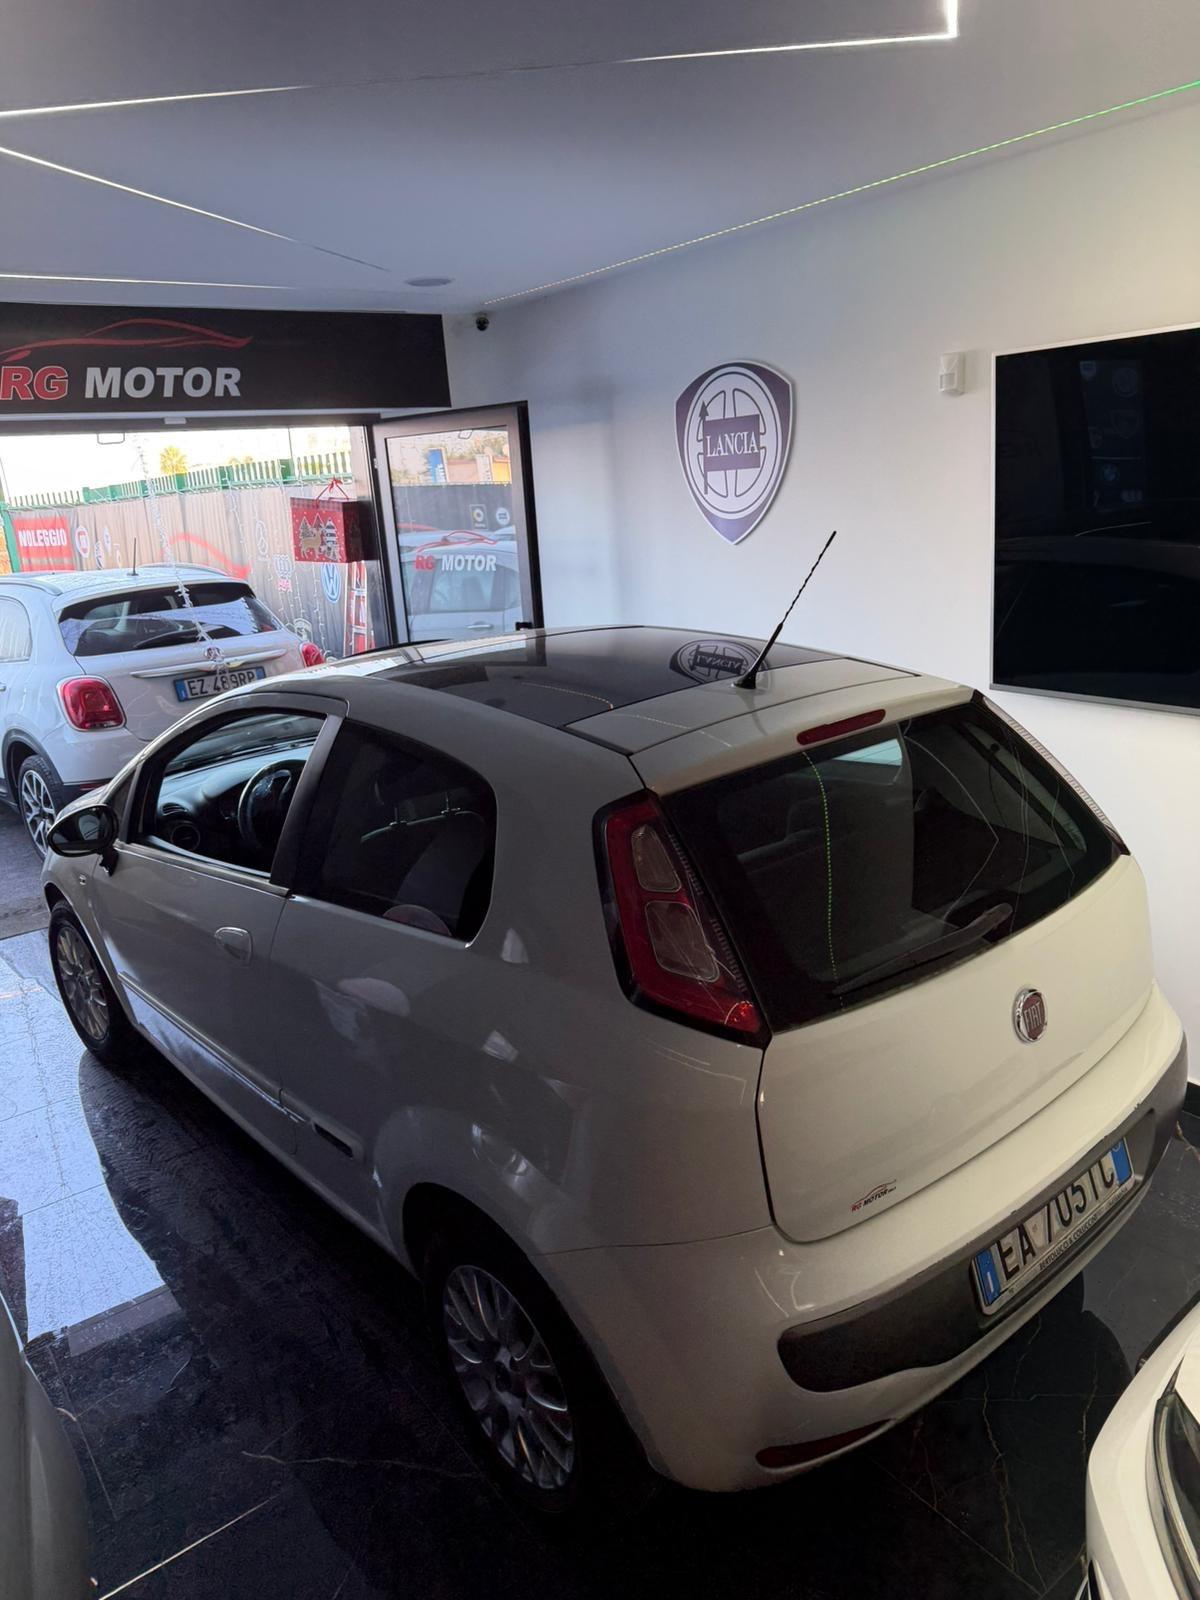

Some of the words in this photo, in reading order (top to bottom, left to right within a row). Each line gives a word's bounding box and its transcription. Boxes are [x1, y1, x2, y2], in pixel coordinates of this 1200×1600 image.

[0, 366, 69, 400] RG
[84, 366, 242, 399] MOTOR
[706, 431, 760, 458] LANCIA
[18, 528, 67, 547] NOLEGGIO
[415, 555, 436, 571] RG
[441, 554, 497, 572] MOTOR
[187, 679, 208, 696] EZ
[1023, 1002, 1042, 1032] FIAT
